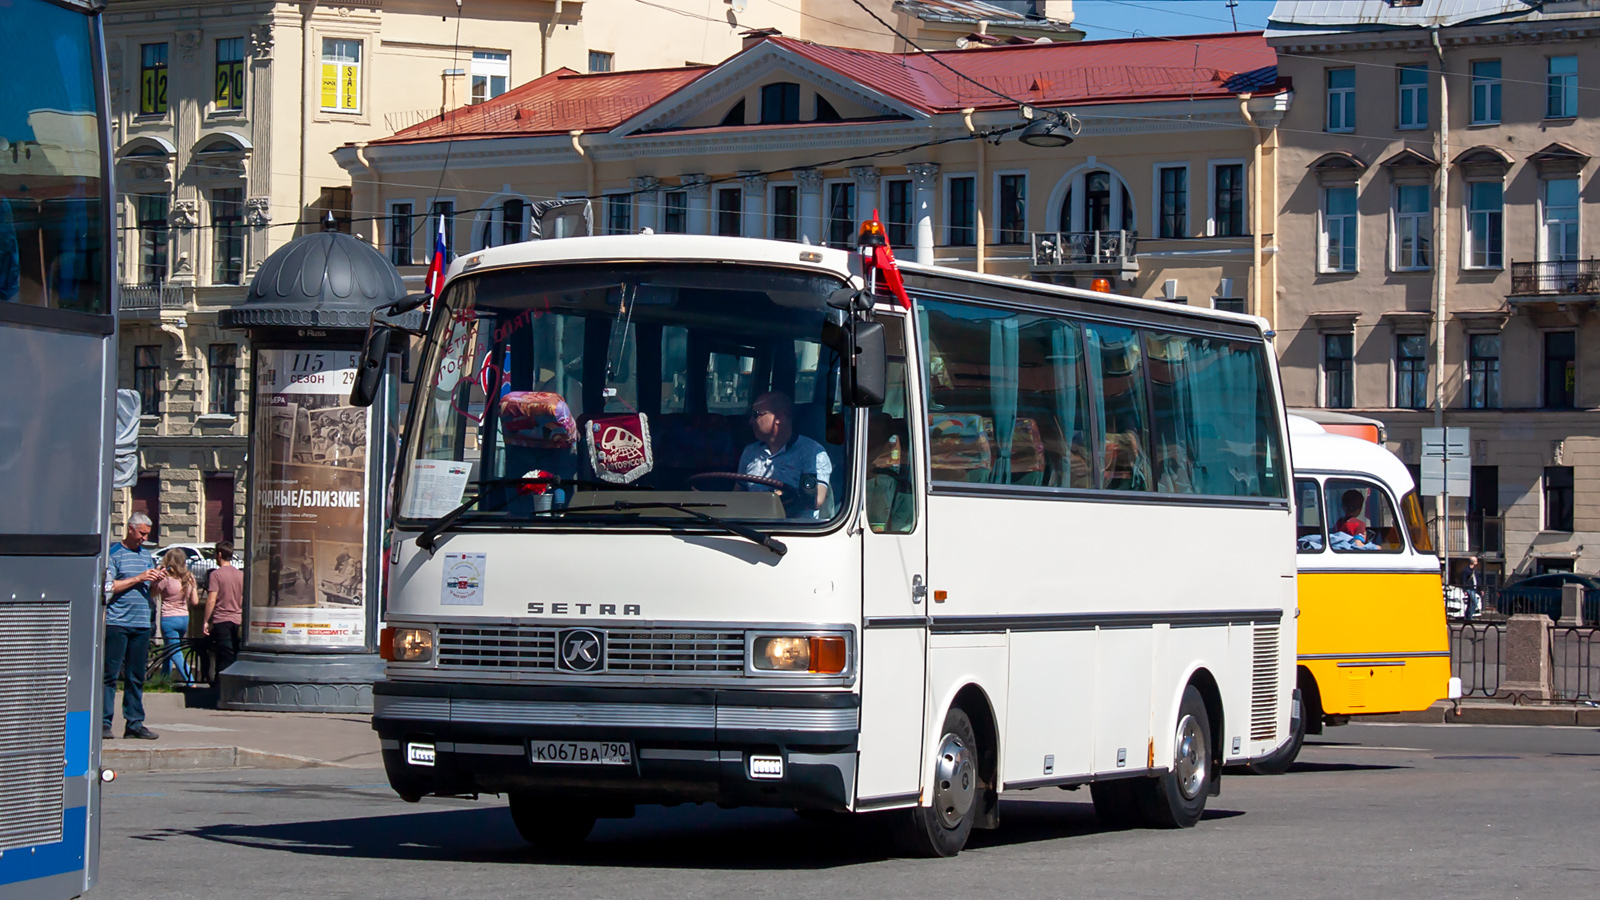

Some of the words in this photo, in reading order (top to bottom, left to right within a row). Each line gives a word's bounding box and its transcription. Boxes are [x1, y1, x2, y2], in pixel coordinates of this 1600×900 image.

[145, 74, 168, 106] 12
[218, 70, 244, 101] 20
[456, 304, 476, 327] 45
[493, 296, 551, 343] ОПЯТЬ!
[291, 353, 325, 372] 115
[290, 374, 325, 384] СЕЗОН
[257, 489, 360, 508] РОДНЫЕ/БЛИЗКИЕ
[527, 602, 641, 616] SETRA
[537, 743, 600, 761] К067ВА
[602, 743, 626, 757] 790
